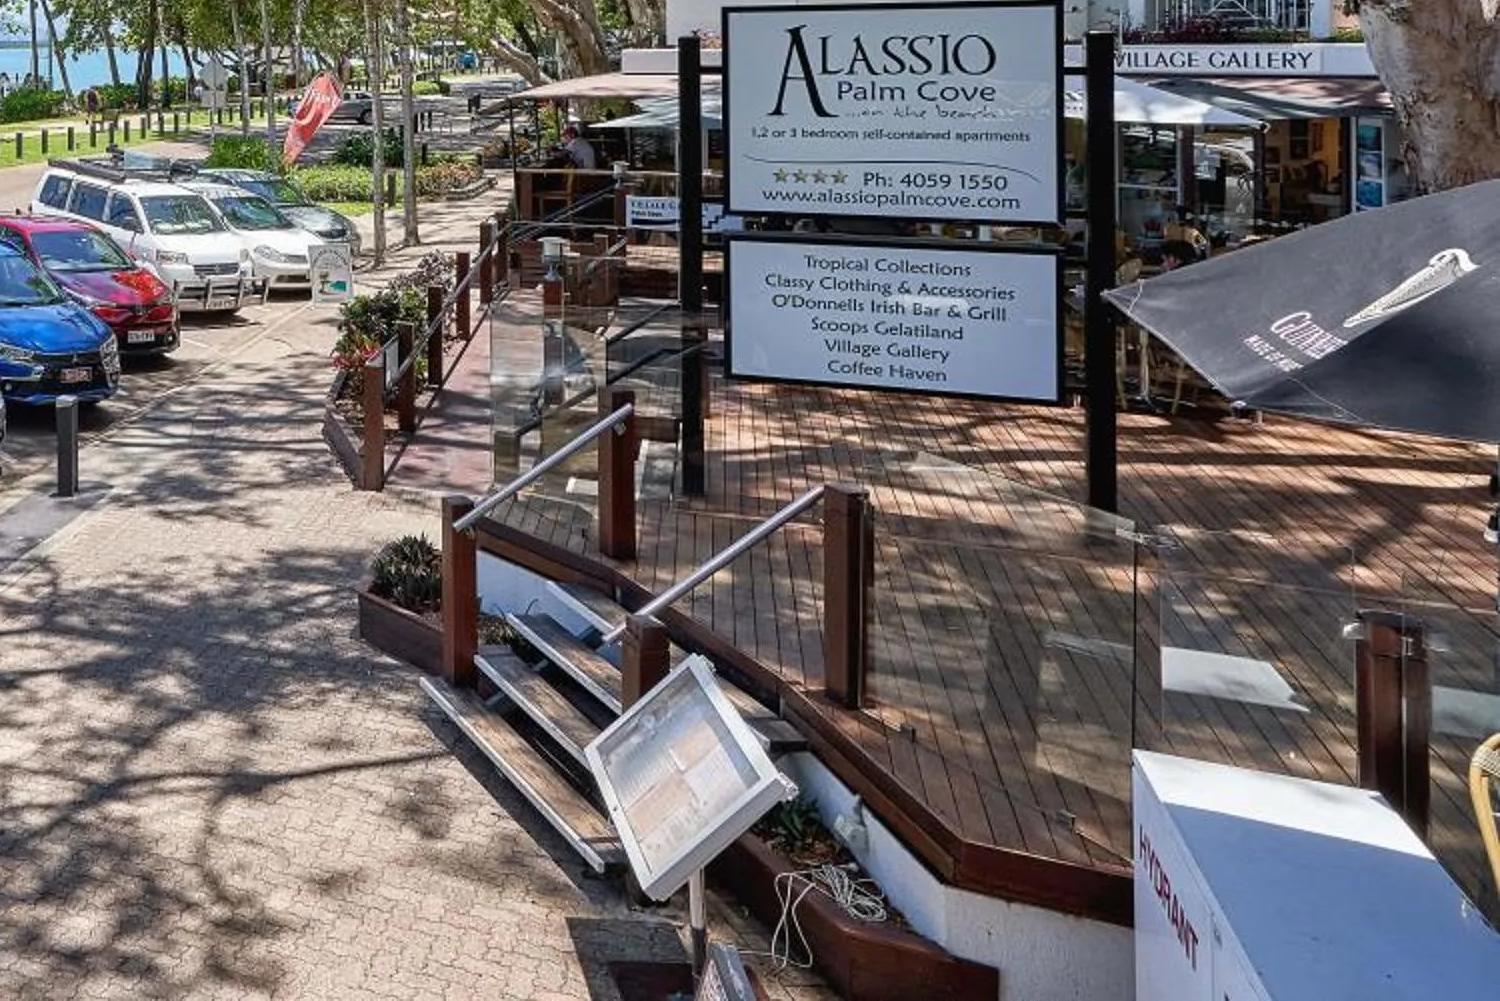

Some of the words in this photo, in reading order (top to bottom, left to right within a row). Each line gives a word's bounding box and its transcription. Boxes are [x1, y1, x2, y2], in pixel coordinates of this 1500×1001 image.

[766, 24, 997, 118] ALASSIO
[1114, 51, 1199, 68] VILLAGE
[1208, 51, 1312, 69] GALLERY
[837, 80, 906, 102] Palm
[918, 81, 996, 102] Cove
[772, 128, 787, 139] or
[789, 127, 797, 139] 3
[801, 127, 858, 139] bedroom
[862, 128, 951, 142] self-contained
[955, 130, 1031, 143] apartments
[863, 172, 893, 187] Ph:
[900, 173, 951, 189] 4059
[959, 174, 1008, 190] 1550
[761, 188, 1021, 209] www.alassiopalmcove.com
[804, 255, 869, 273] Tropical
[875, 258, 972, 277] Collections
[764, 274, 814, 292] Classy
[819, 276, 891, 297] Clothing
[898, 281, 912, 296] &
[917, 282, 1015, 301] Accessories
[772, 294, 864, 313] O'Donnells
[871, 299, 905, 315] Irish
[913, 302, 940, 317] Bar
[947, 304, 962, 319] &
[968, 306, 1006, 322] Grill
[811, 317, 869, 335] Scoops
[874, 321, 964, 340] Gelatiland
[824, 339, 881, 357] Village
[887, 343, 949, 362] Gallery
[827, 360, 883, 378] Coffee
[889, 364, 947, 383] Haven
[1139, 825, 1199, 972] HYDRANT
